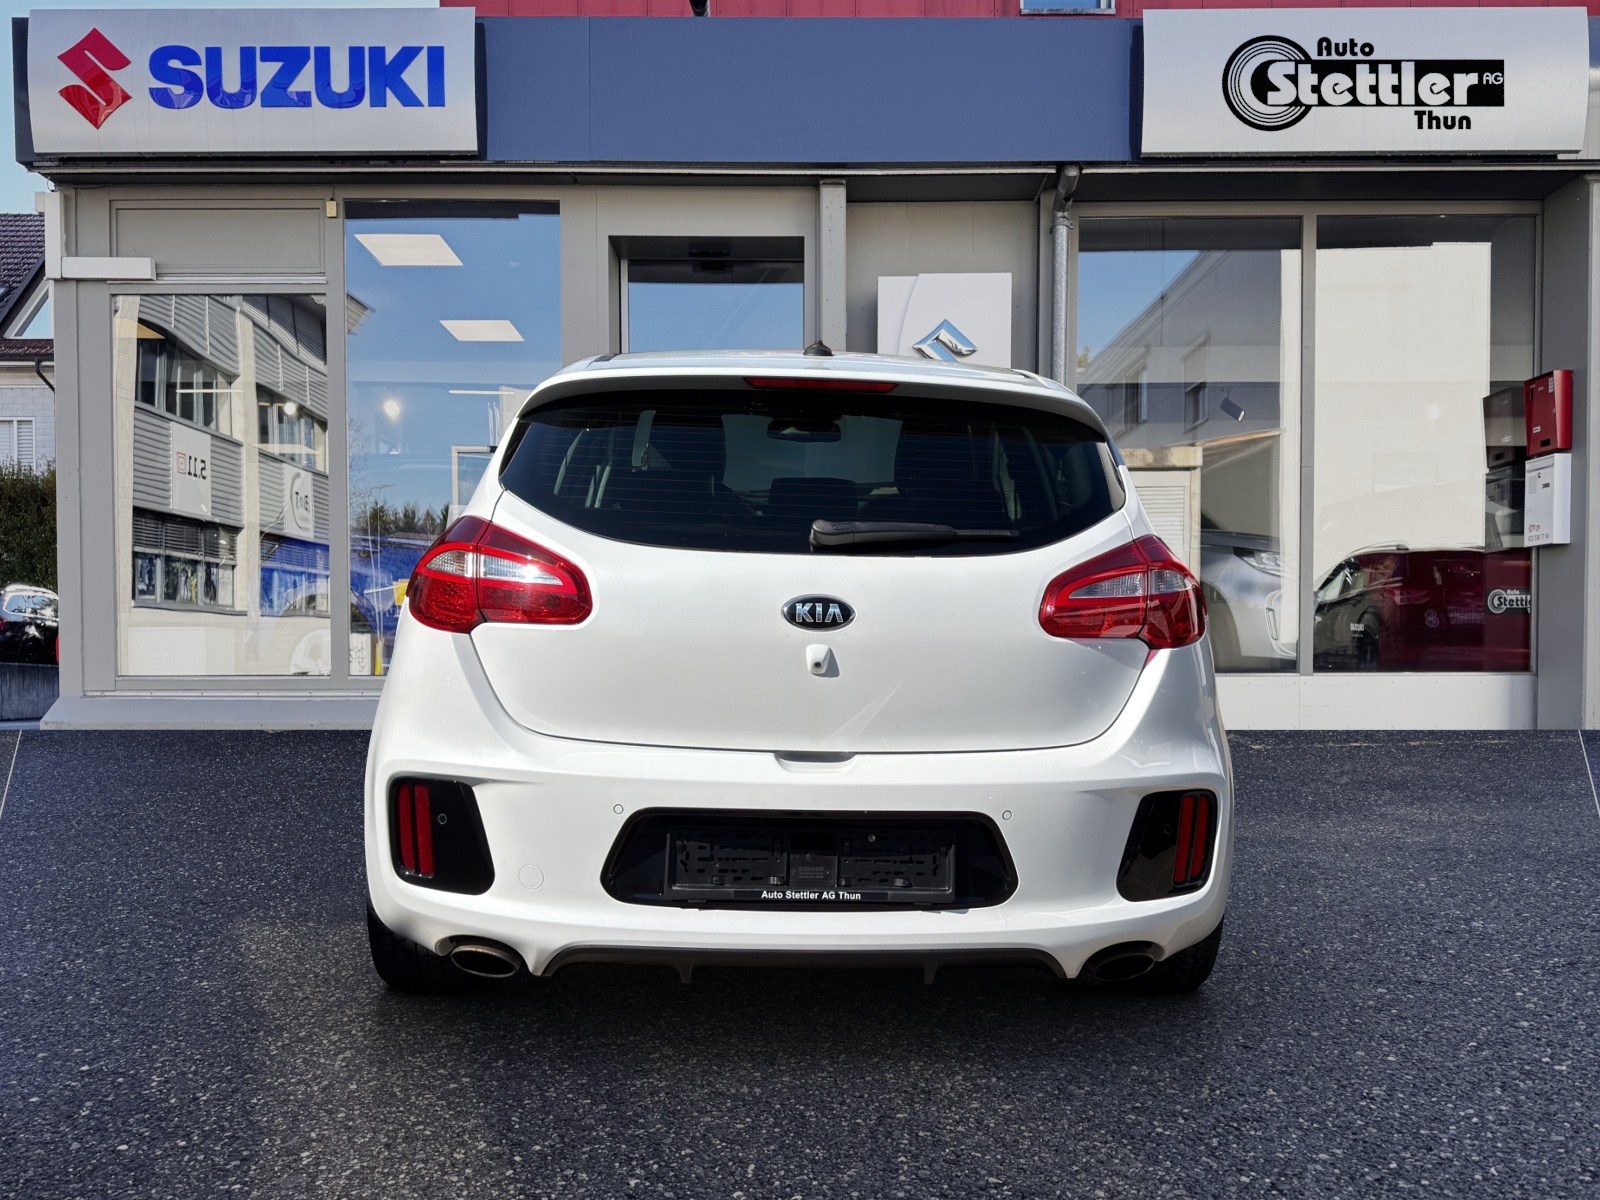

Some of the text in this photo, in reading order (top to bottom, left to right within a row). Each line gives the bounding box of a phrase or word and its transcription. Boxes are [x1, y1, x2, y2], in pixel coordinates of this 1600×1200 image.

[1317, 37, 1375, 57] Auto
[148, 44, 446, 109] SUZUKI
[1266, 60, 1504, 106] Stettler AG
[1414, 110, 1472, 130] Thun
[1496, 595, 1530, 607] Stettl
[795, 602, 844, 623] KIA
[761, 890, 862, 900] Auto Stettler AG Thun
